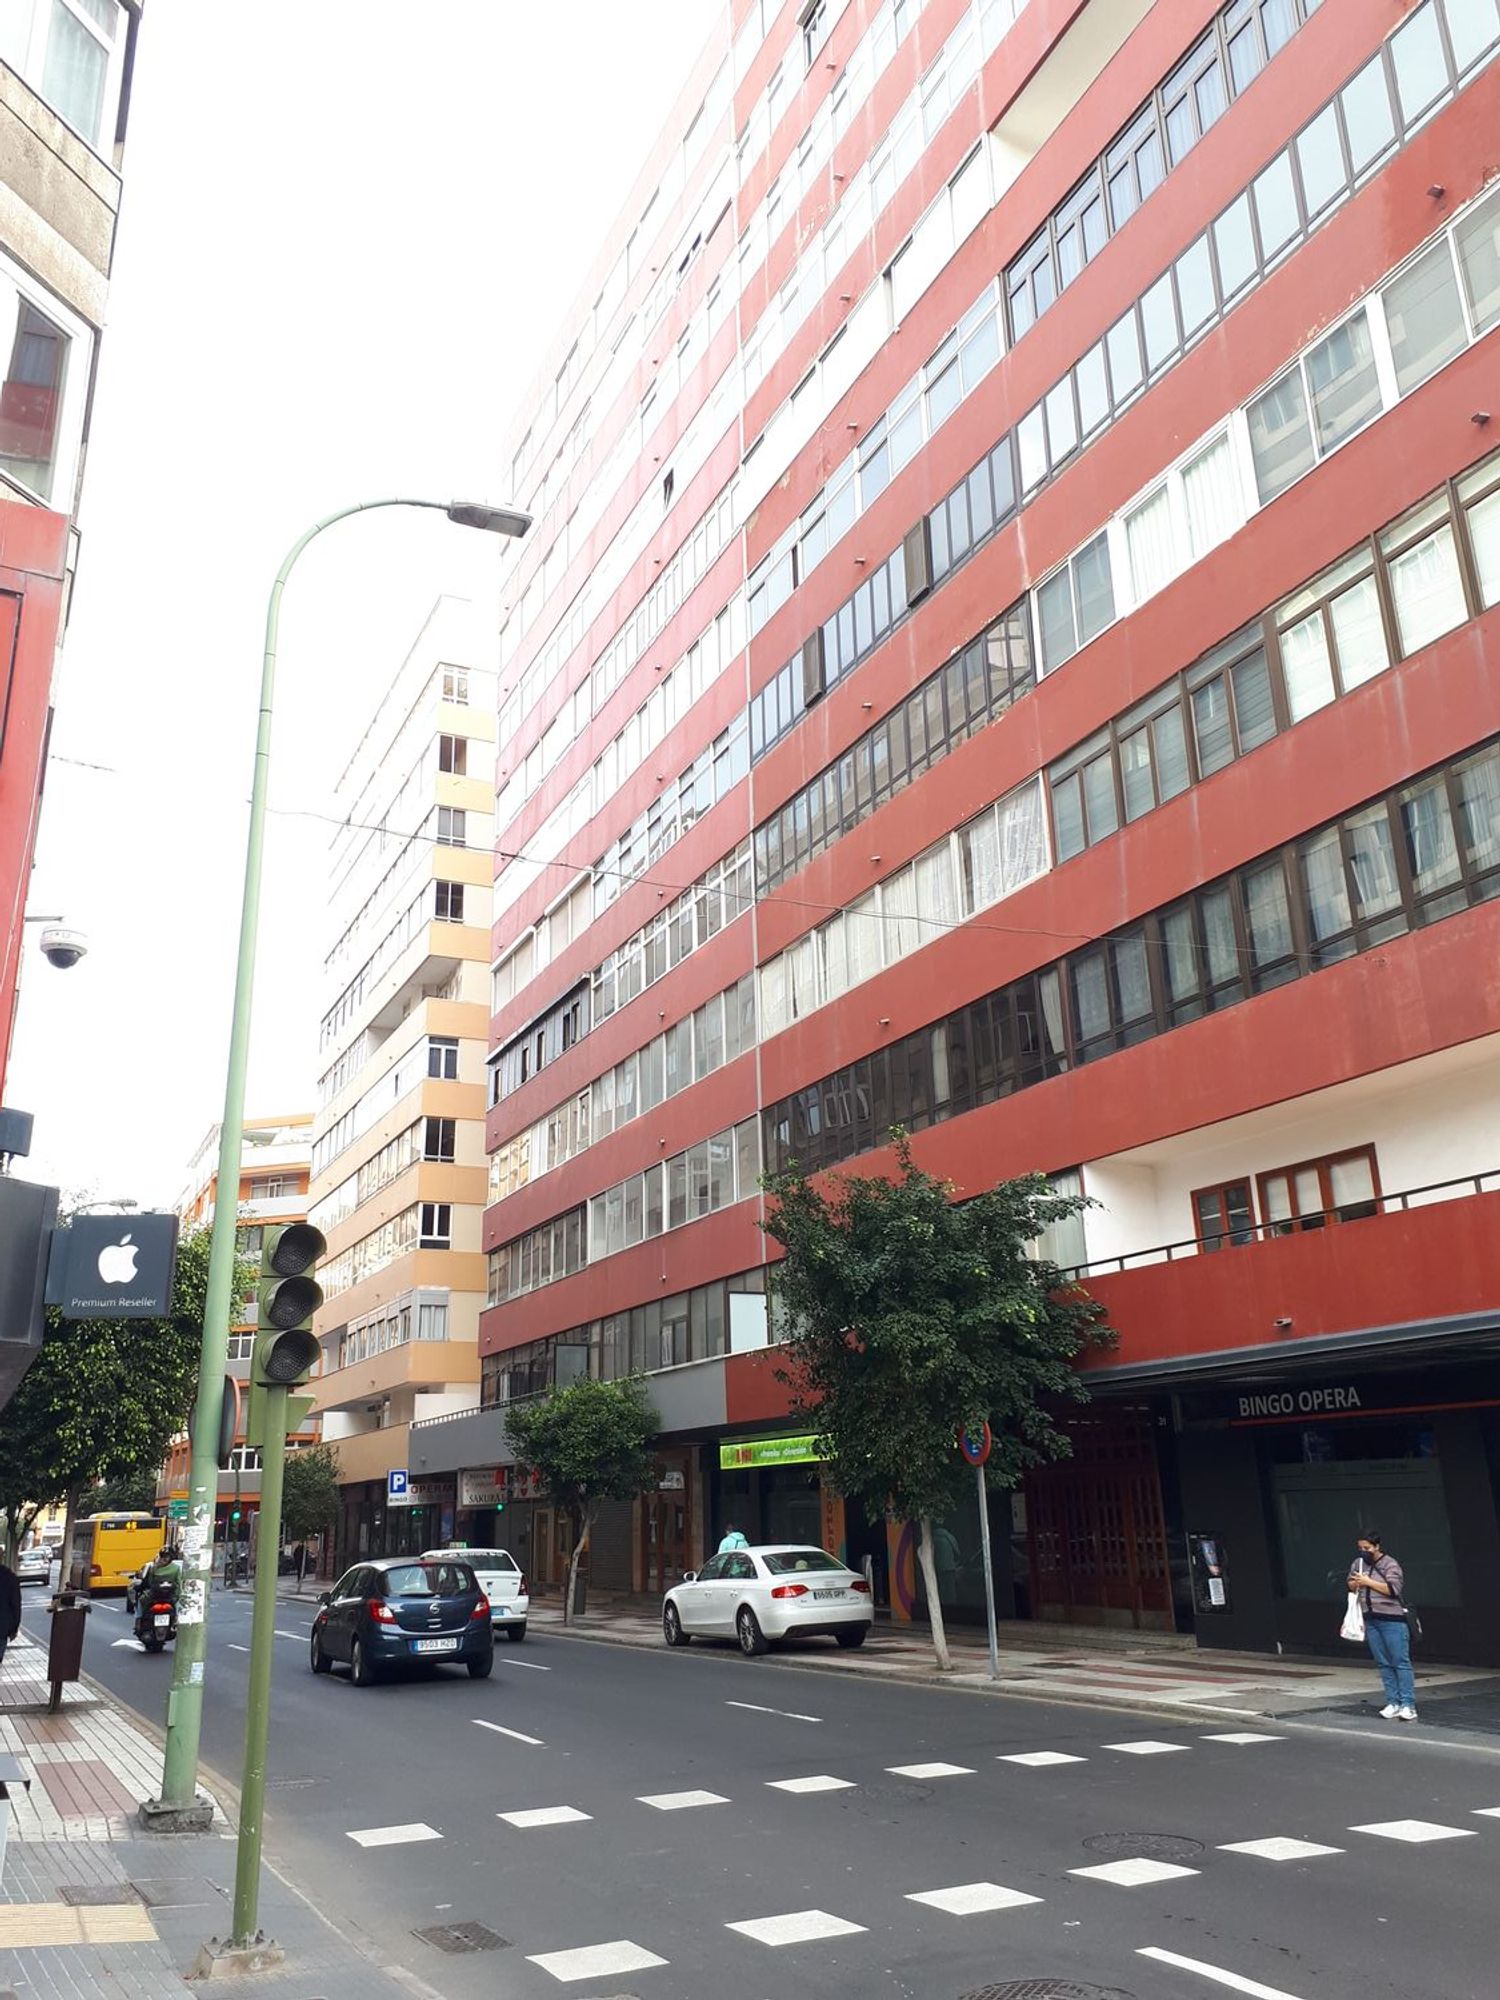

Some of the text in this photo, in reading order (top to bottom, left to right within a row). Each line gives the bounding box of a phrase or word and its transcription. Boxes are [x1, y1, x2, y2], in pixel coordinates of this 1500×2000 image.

[71, 1297, 157, 1308] Premium Reseller
[1239, 1386, 1361, 1417] BINGO OPERA
